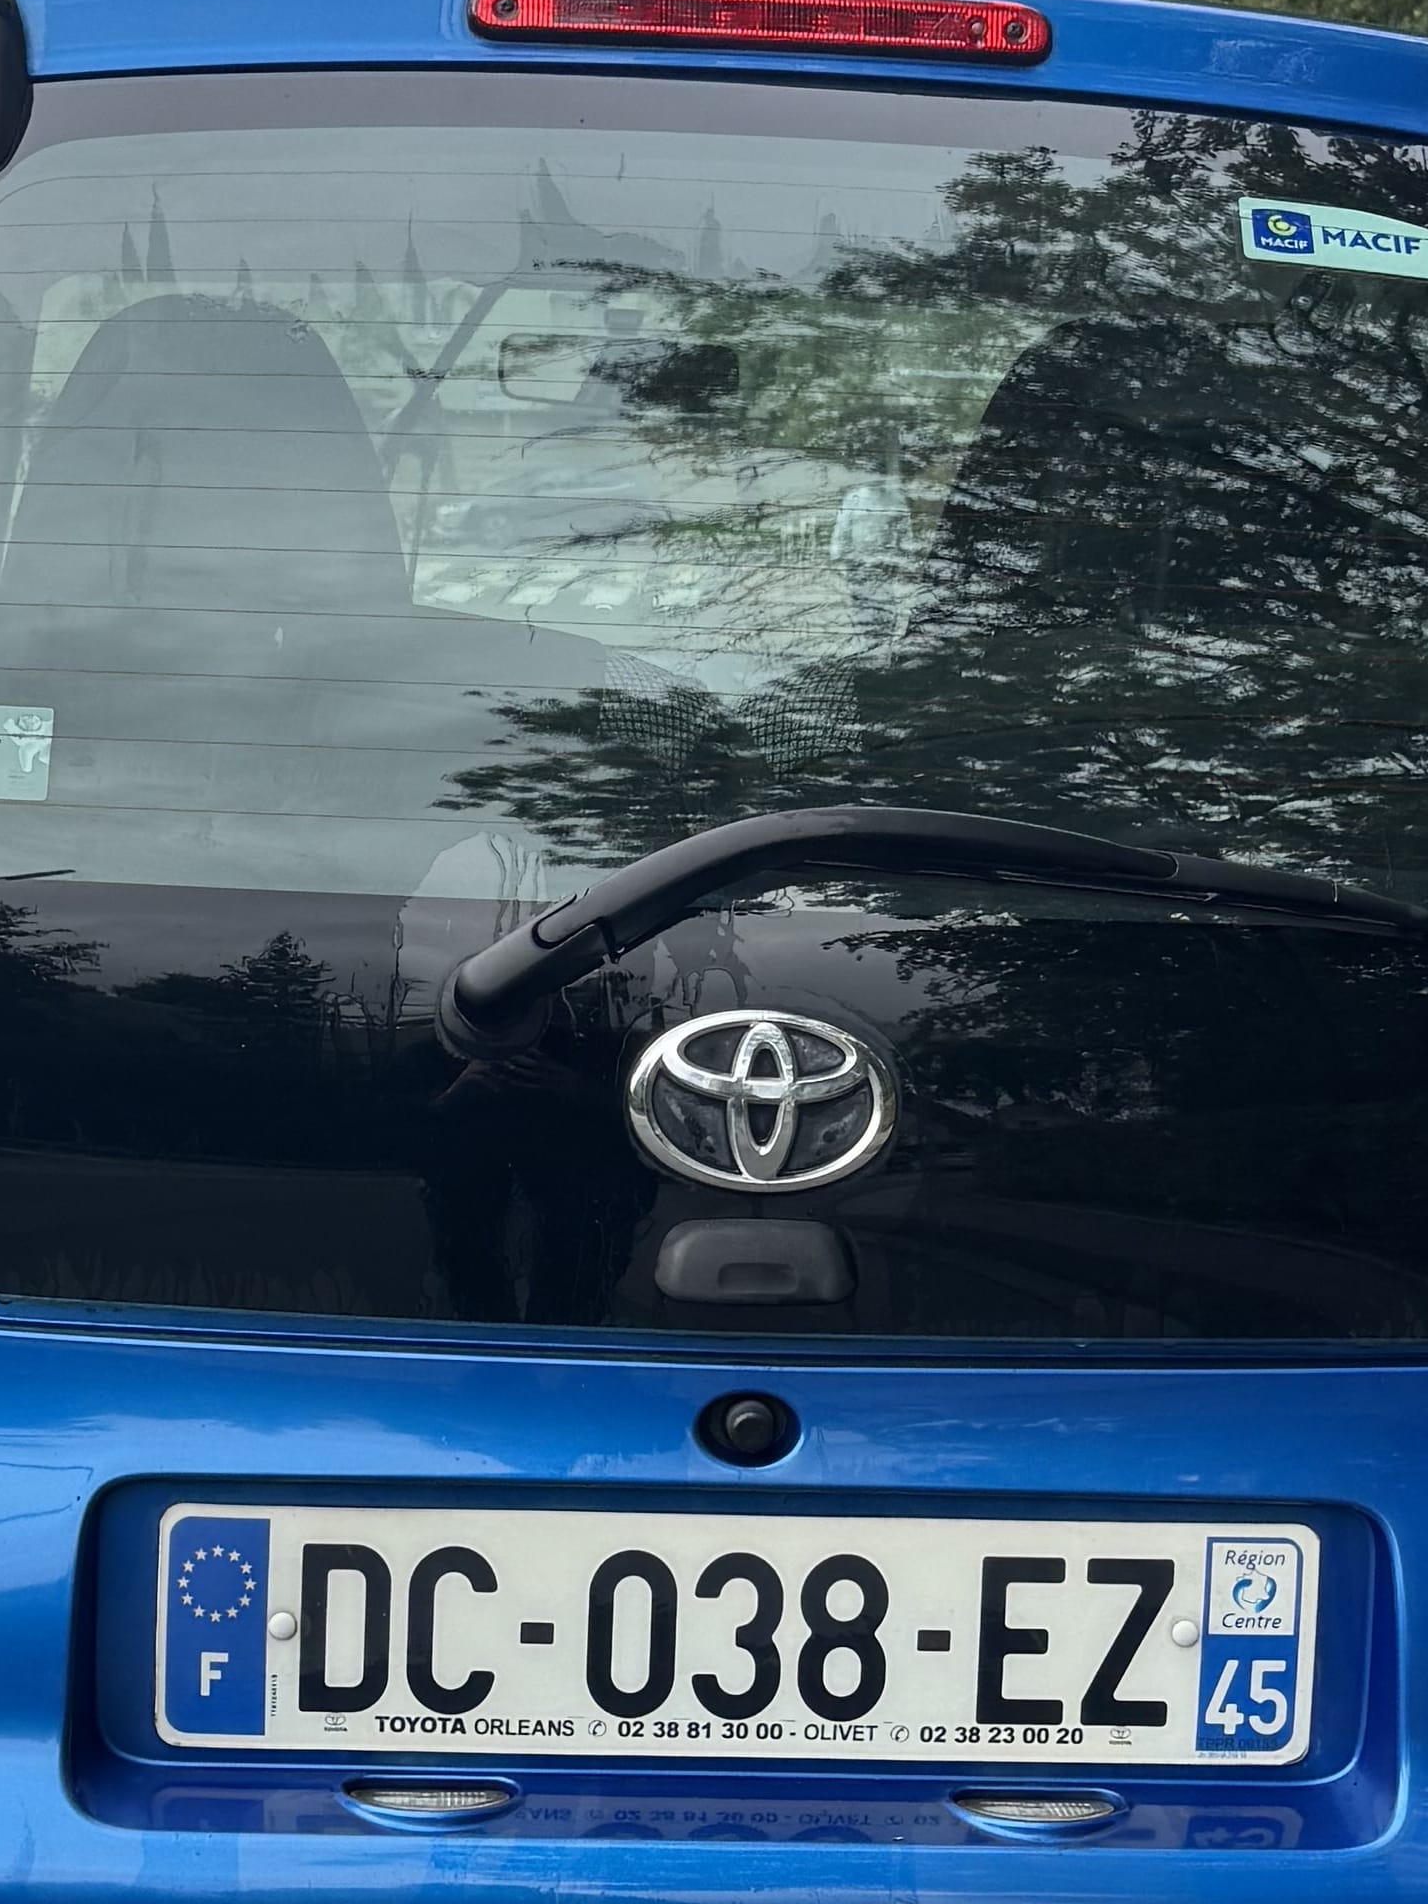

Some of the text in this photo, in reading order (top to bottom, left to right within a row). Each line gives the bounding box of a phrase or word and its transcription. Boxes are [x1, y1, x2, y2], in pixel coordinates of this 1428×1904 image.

[1260, 236, 1308, 250] MACIF
[1322, 226, 1421, 254] MACIF
[1224, 1549, 1286, 1570] Région
[298, 1542, 1175, 1728] DC-038-EZ
[1221, 1612, 1283, 1630] Centre
[200, 1652, 229, 1696] F
[1204, 1659, 1288, 1735] 45
[375, 1716, 467, 1734] TOYOTA
[474, 1718, 575, 1736] ORLEANS
[618, 1721, 644, 1737] 02
[653, 1721, 679, 1738] 38
[686, 1722, 711, 1739] 81
[721, 1722, 748, 1739] 30
[756, 1723, 783, 1740] 00
[804, 1724, 878, 1741] OLIVET
[920, 1726, 946, 1743] 02
[954, 1726, 980, 1743] 38
[987, 1727, 1015, 1744] 23
[1022, 1727, 1049, 1744] 00
[1056, 1728, 1083, 1745] 20
